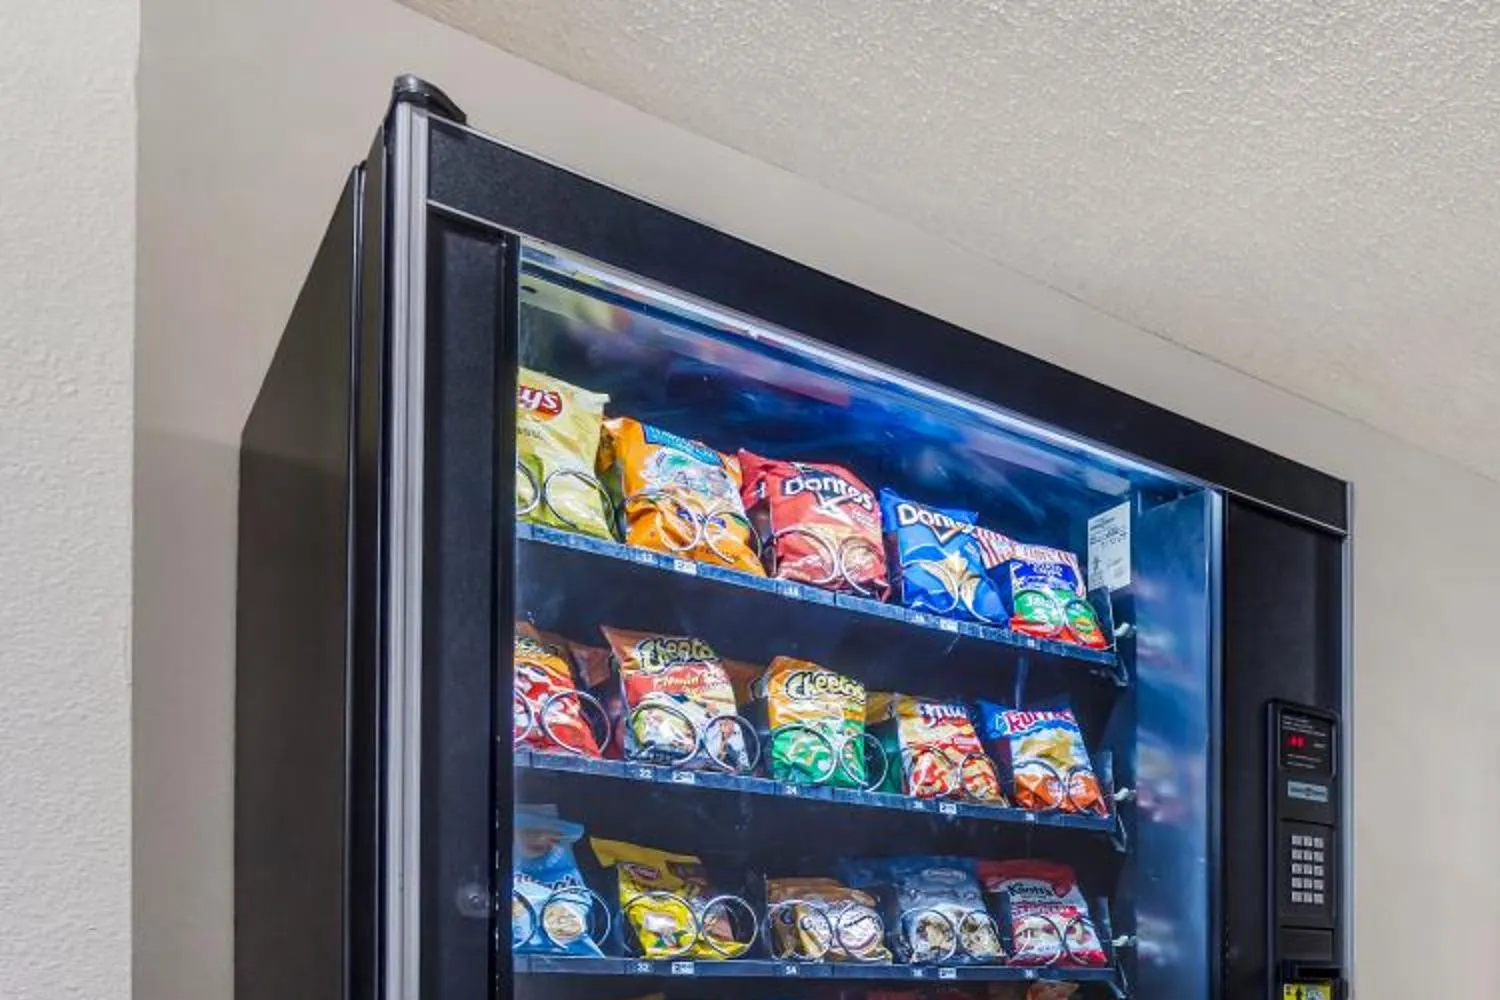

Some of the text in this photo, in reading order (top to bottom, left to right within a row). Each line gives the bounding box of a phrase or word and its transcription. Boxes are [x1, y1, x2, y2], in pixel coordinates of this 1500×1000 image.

[785, 476, 873, 511] Doritos
[636, 638, 717, 674] Cheeto
[785, 671, 866, 704] Cheetos
